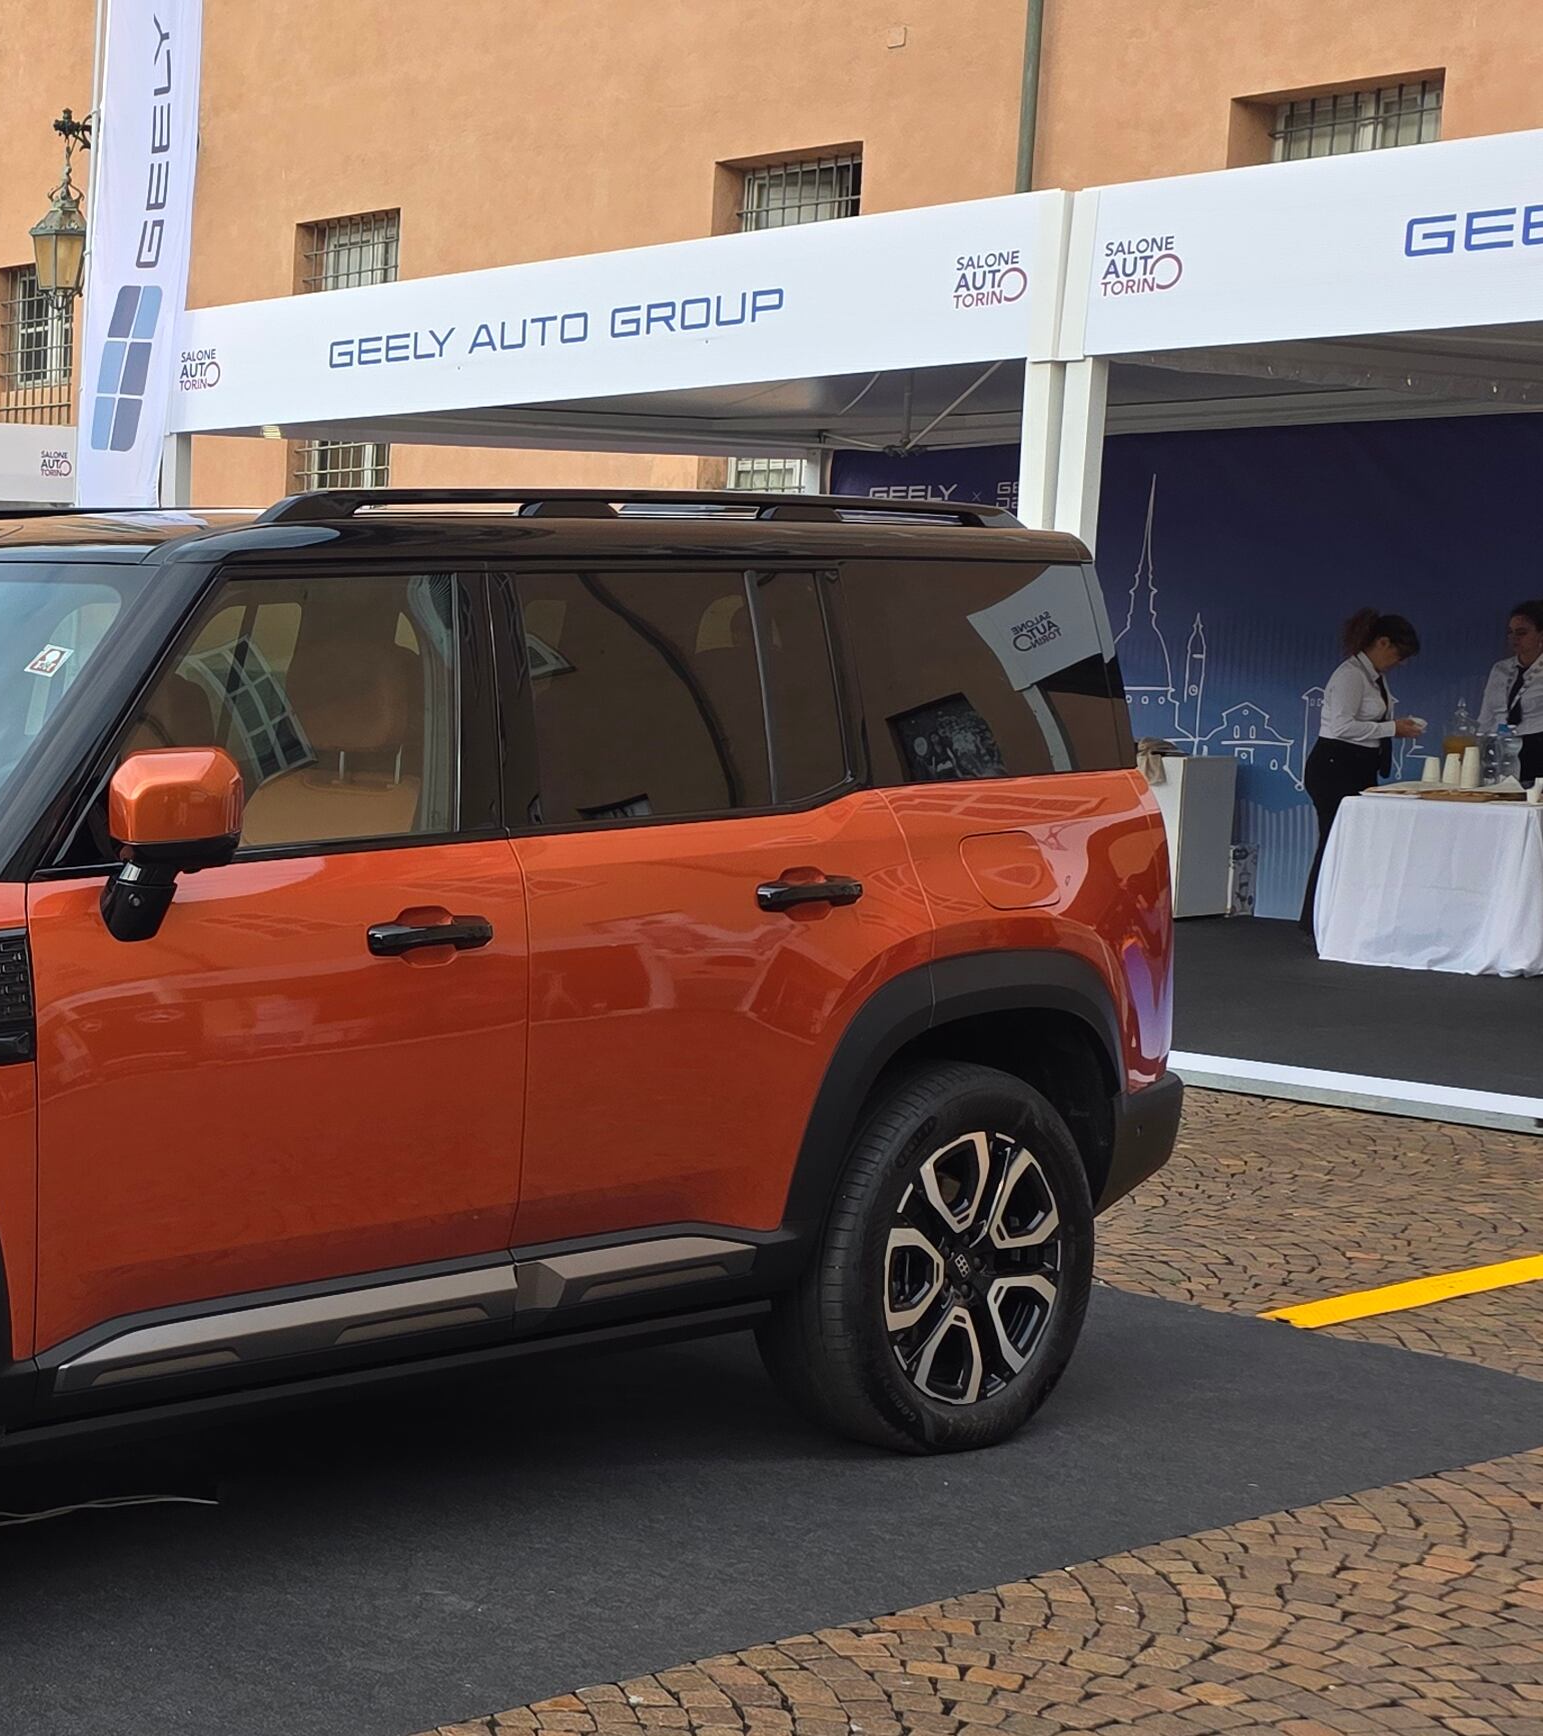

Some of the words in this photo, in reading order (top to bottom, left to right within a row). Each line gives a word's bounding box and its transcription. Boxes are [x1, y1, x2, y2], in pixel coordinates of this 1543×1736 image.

[136, 13, 171, 268] GEELY
[1105, 236, 1175, 257] SALONE
[956, 250, 1020, 271] SALONE
[1102, 253, 1183, 286] AUTO
[954, 267, 1027, 299] AUTO
[329, 327, 456, 369] GEELY
[468, 312, 588, 354] AUTO
[610, 288, 784, 338] GROUP
[181, 348, 216, 363] SALONE
[180, 361, 220, 384] AUTO
[869, 484, 957, 500] GEELY
